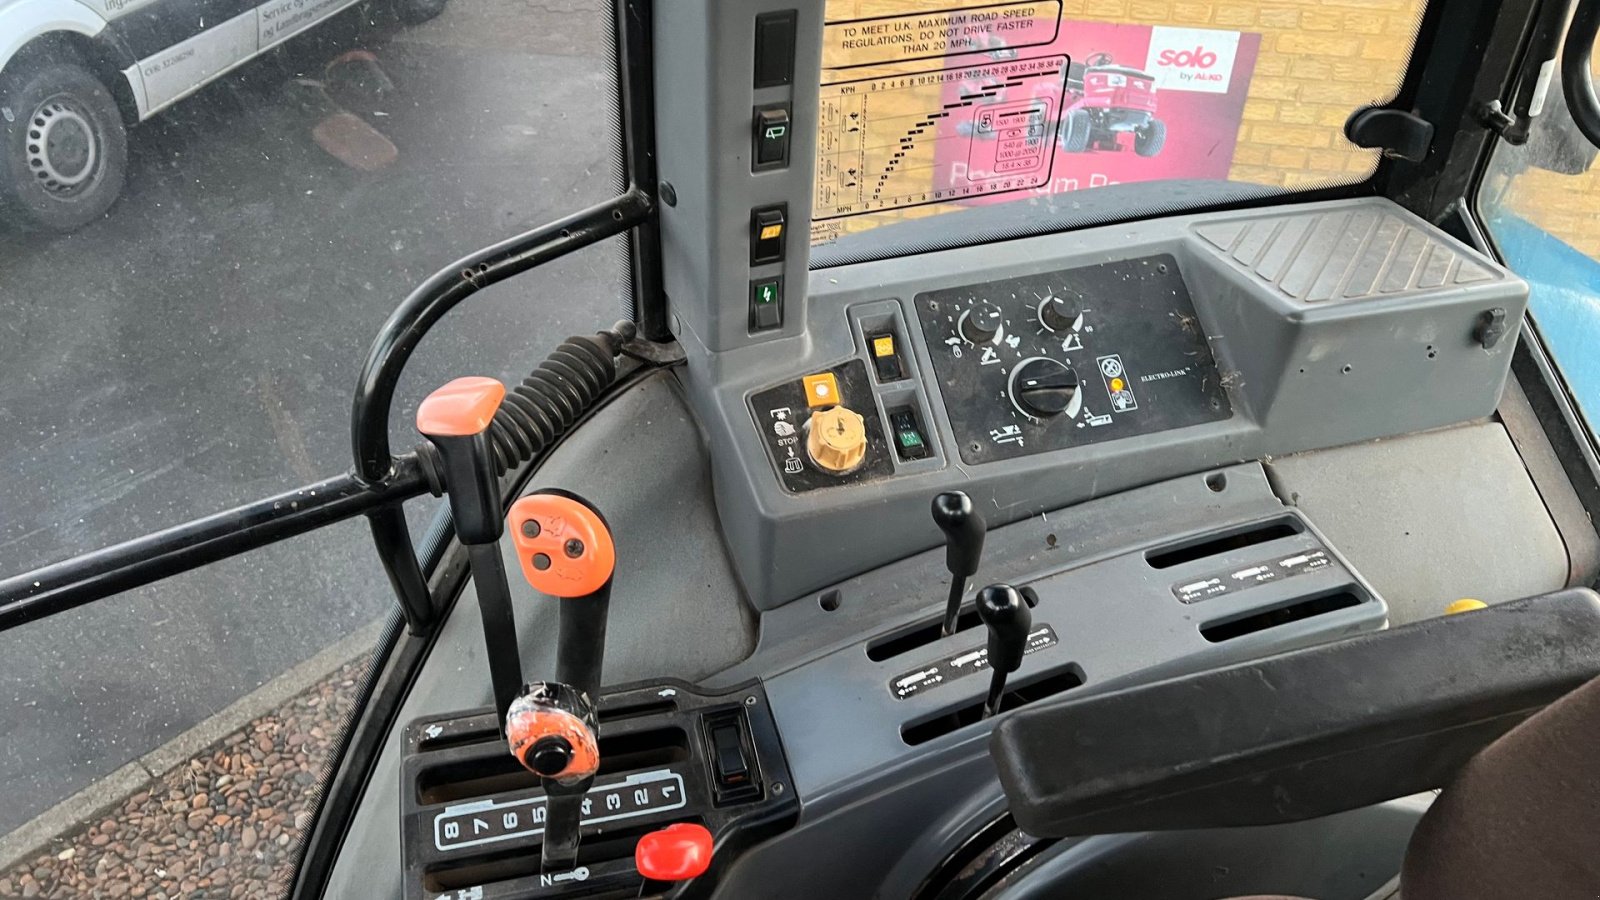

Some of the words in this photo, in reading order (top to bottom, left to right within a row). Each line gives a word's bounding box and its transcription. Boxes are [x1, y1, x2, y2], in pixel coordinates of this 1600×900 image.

[263, 3, 291, 21] Service
[843, 28, 857, 37] TO
[861, 24, 890, 35] MEET
[894, 22, 913, 32] U.K.
[918, 15, 966, 29] MAXIMUM
[971, 12, 998, 22] ROAD
[1003, 8, 1035, 19] SPEED
[919, 31, 934, 40] DO
[939, 28, 959, 38] NOT
[963, 24, 992, 35] DRIVE
[997, 20, 1034, 31] FASTER
[902, 43, 929, 54] THAN
[933, 41, 946, 51] 20
[1156, 46, 1217, 69] solo
[1180, 72, 1193, 81] by
[840, 86, 856, 95] KPH
[836, 206, 852, 214] MPH
[777, 436, 799, 447] STOP
[444, 821, 459, 839] 8
[473, 818, 489, 835] 7
[503, 812, 518, 829] 6
[532, 806, 546, 824] 5
[581, 798, 592, 815] 4
[606, 793, 621, 810] 3
[634, 788, 649, 805] 2
[661, 785, 676, 798] 1
[540, 873, 552, 888] N
